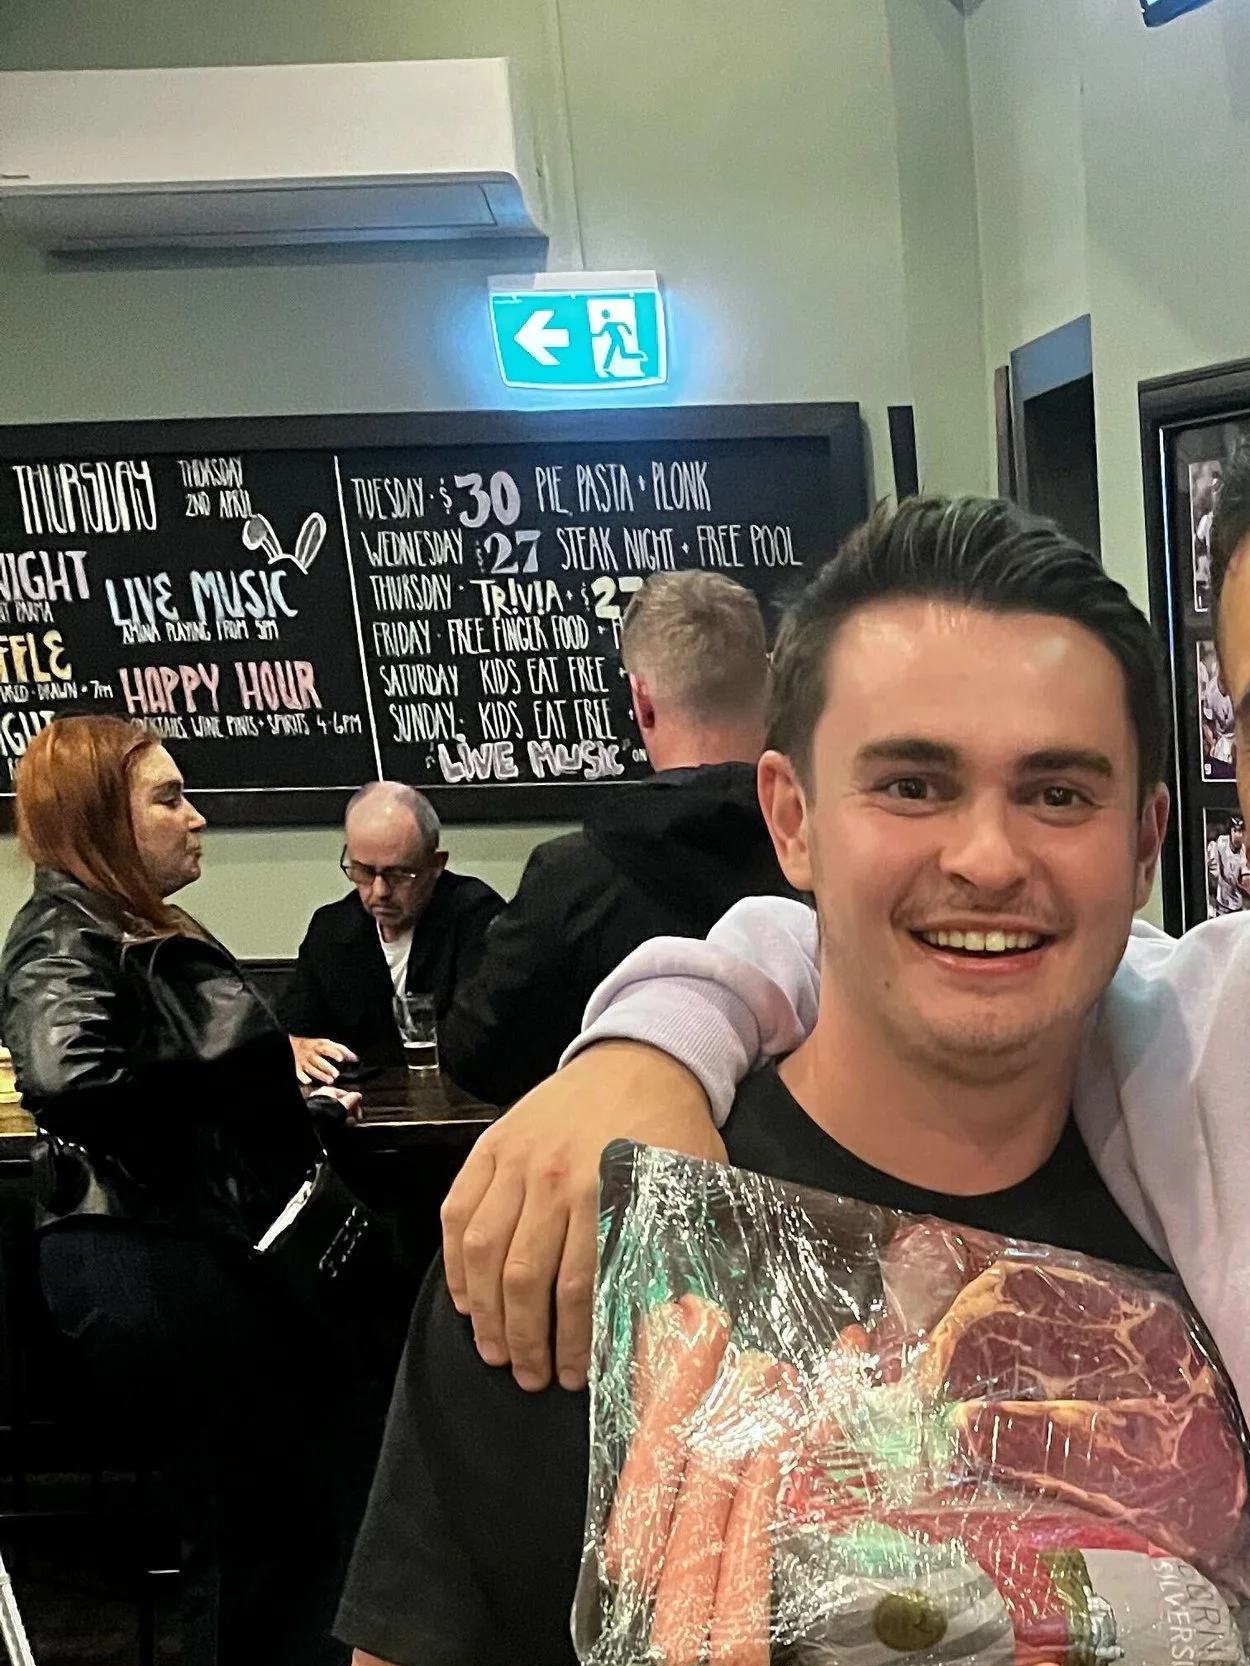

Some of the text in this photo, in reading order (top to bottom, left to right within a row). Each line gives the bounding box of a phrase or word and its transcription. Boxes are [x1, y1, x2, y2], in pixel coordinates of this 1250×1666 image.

[176, 457, 243, 487] THURSDAY
[351, 477, 424, 520] TUESDAY
[440, 470, 521, 528] $30
[576, 463, 634, 512] PASTA
[652, 460, 711, 512] PLONK
[12, 460, 157, 534] THURSDAY
[185, 488, 257, 520] 2ND APRIL
[360, 528, 464, 568] WEDNESDAY
[556, 526, 619, 571] STEAK
[624, 526, 677, 571] NIGHT
[697, 524, 744, 568] FREE
[750, 524, 804, 567] POOL
[105, 569, 298, 627] LIVE MUSIC
[369, 573, 452, 611] THURSDAY
[372, 619, 432, 657] FRIDAY
[447, 617, 491, 655] FREE
[492, 616, 549, 653] FINGER
[551, 615, 590, 650] FOOD
[119, 660, 323, 714] HAPPY HOUR
[379, 656, 610, 697] SATURDAY KIDS EAT FREE
[388, 698, 618, 742] SUNDAY KIDS EAT FREE
